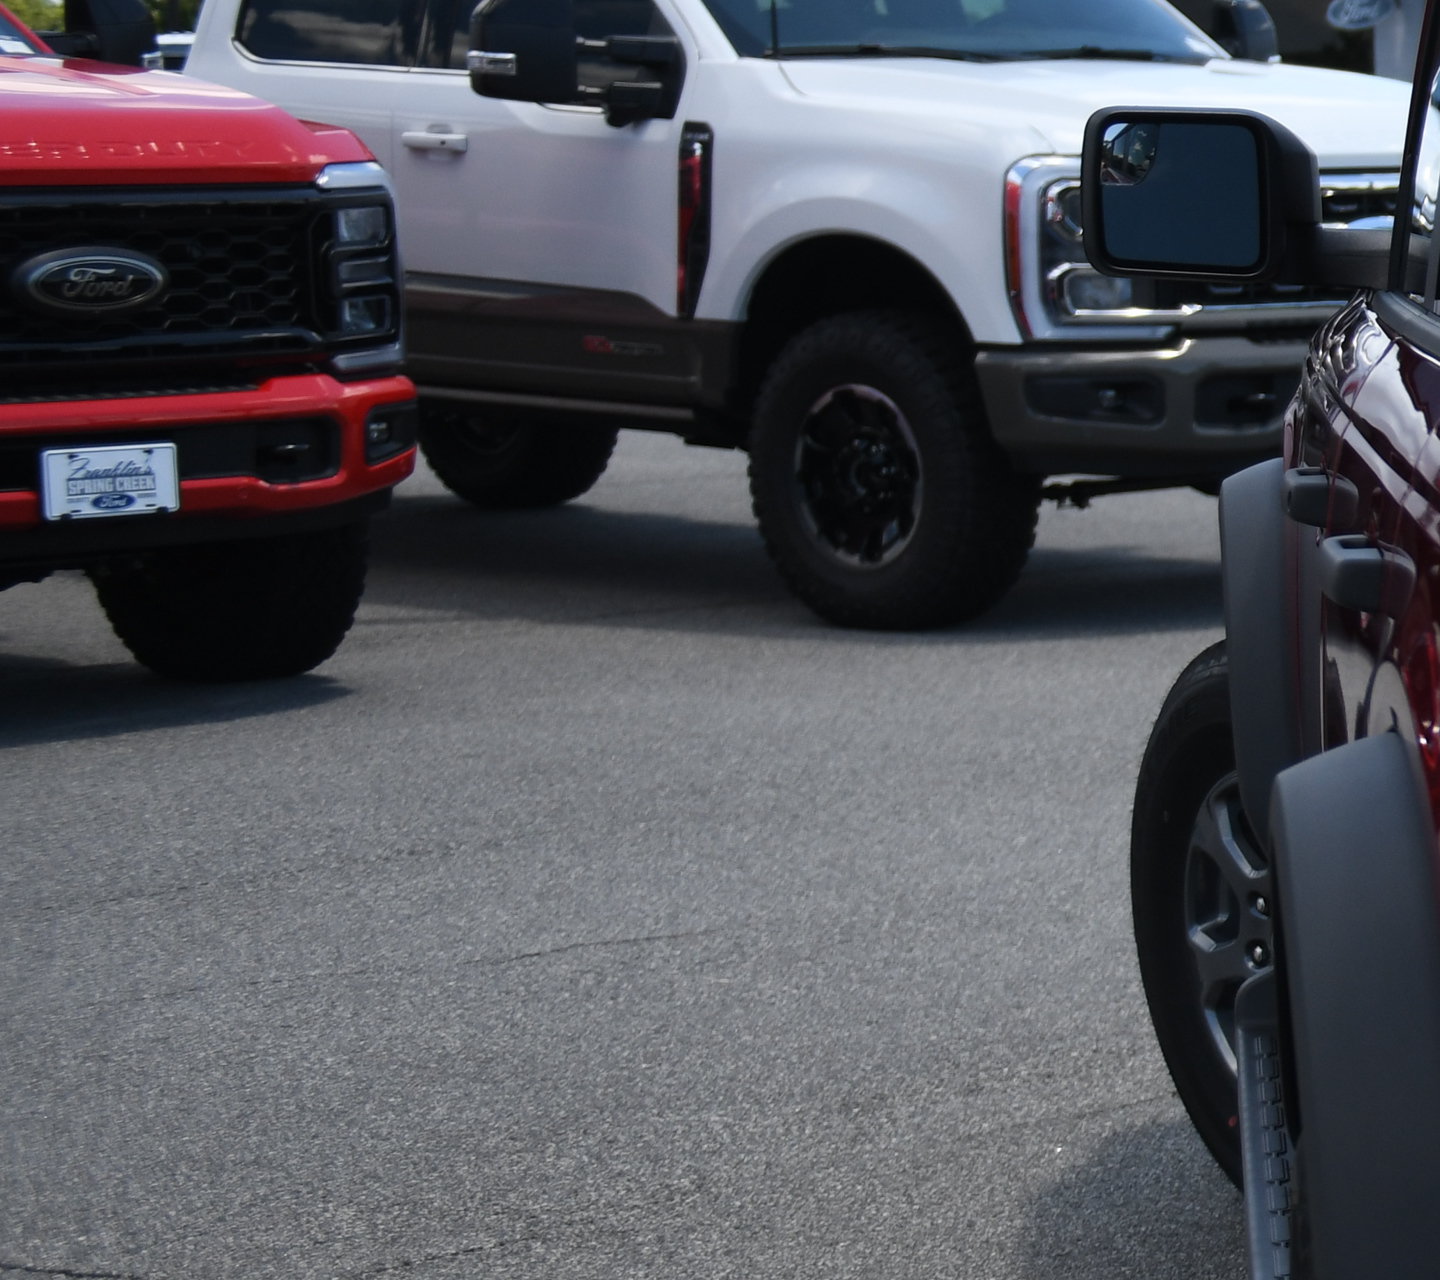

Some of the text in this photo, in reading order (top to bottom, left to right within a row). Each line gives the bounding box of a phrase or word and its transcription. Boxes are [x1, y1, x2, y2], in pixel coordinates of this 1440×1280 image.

[63, 267, 134, 297] Ford
[69, 477, 155, 494] SPRING CREEK
[100, 496, 127, 508] Ford
